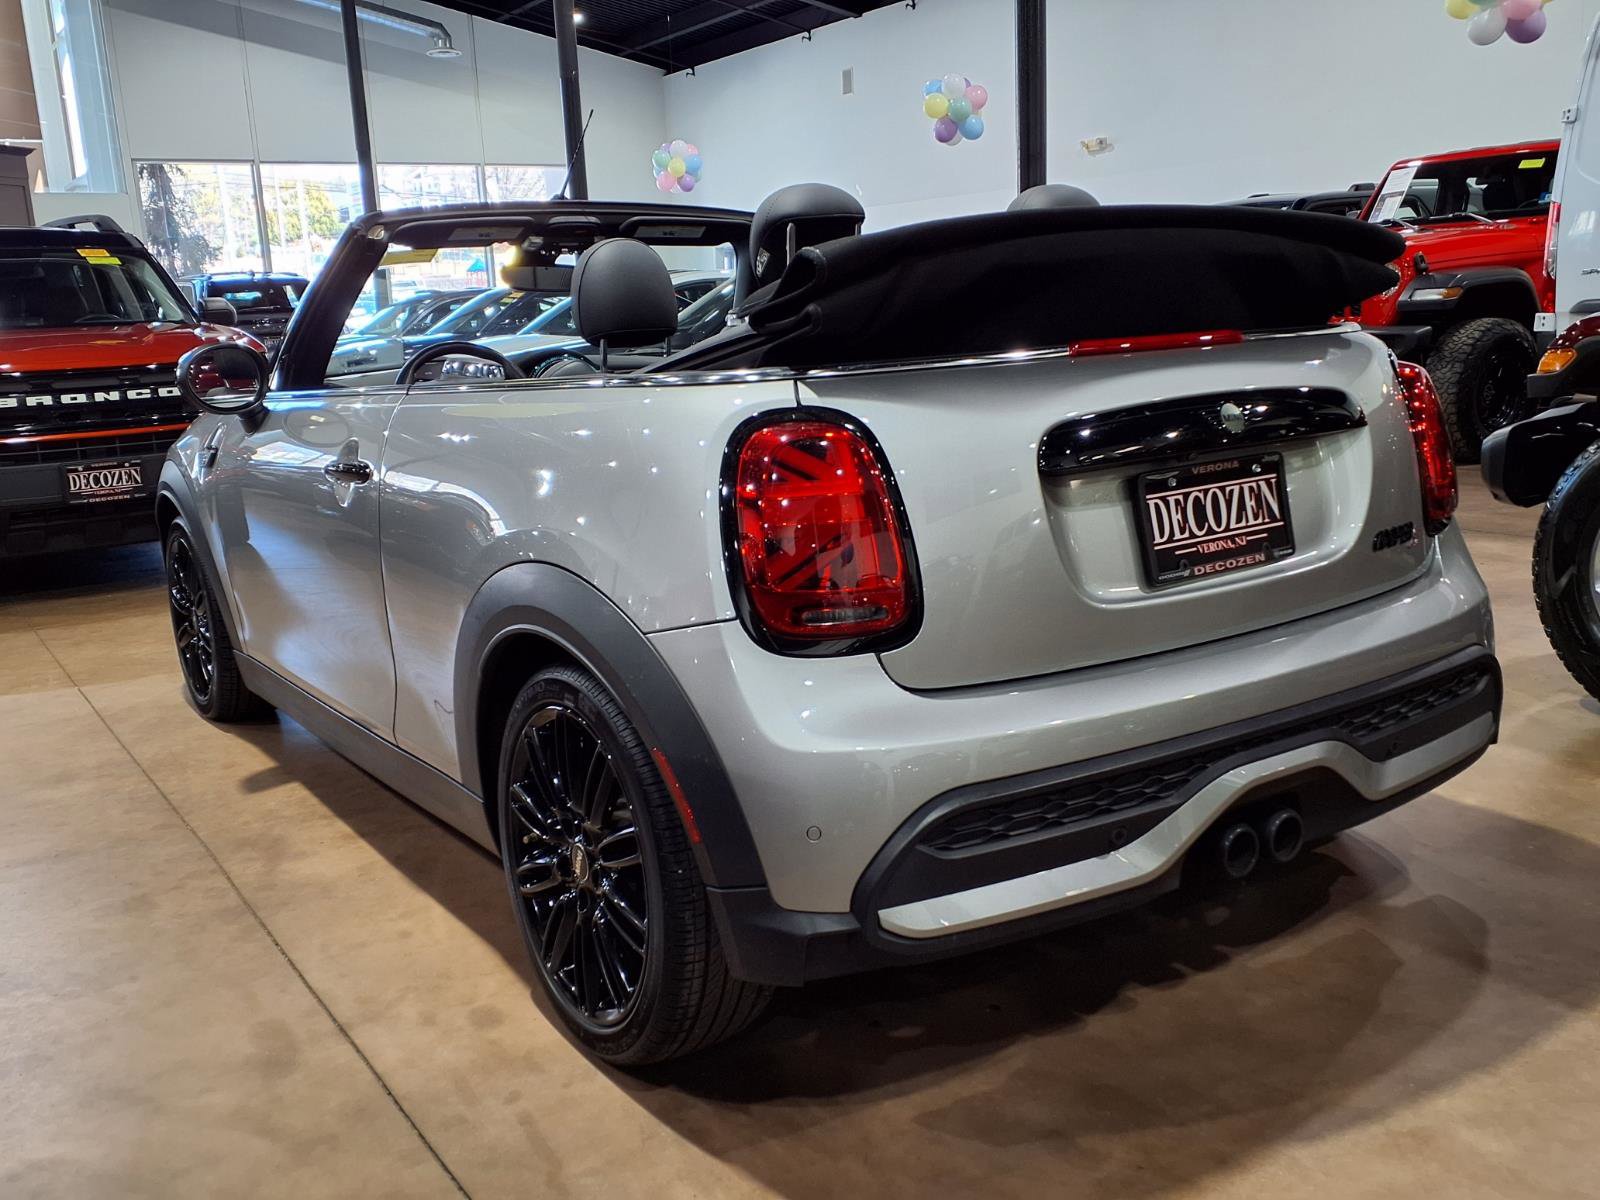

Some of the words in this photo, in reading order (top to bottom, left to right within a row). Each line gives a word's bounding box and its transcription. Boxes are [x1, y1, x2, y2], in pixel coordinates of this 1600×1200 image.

[0, 386, 181, 408] BRONCO
[1192, 460, 1240, 474] VERONA
[69, 468, 142, 491] DECOZEN
[1147, 478, 1281, 544] DECOZEN
[1194, 553, 1266, 576] DECOZEN
